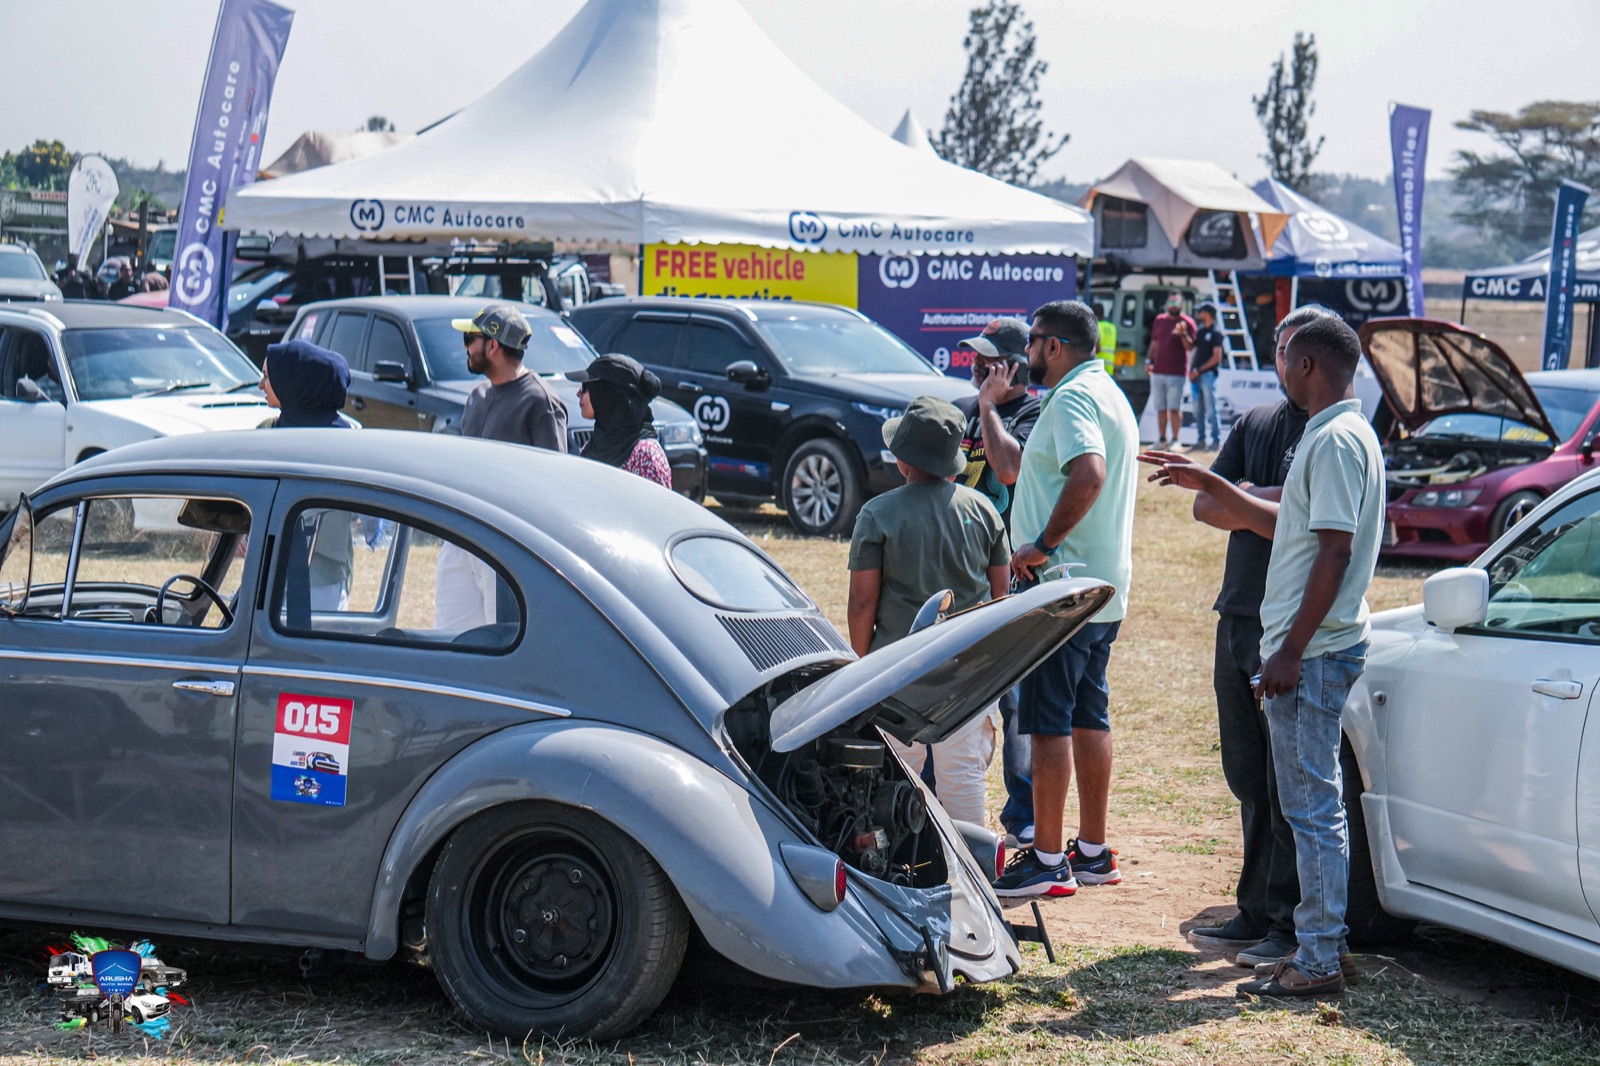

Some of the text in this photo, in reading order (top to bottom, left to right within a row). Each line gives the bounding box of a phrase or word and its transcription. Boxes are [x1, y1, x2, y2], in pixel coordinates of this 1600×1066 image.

[195, 60, 240, 235] CMC Autocare
[1402, 126, 1417, 264] Automobiles
[394, 206, 525, 228] CMC Autocare
[838, 221, 975, 243] CMC Autocare
[655, 249, 805, 281] FREE vehicle
[927, 259, 1064, 282] CMC Autocare
[1471, 278, 1520, 296] CMC
[922, 313, 968, 325] Authorized
[283, 701, 341, 735] 015
